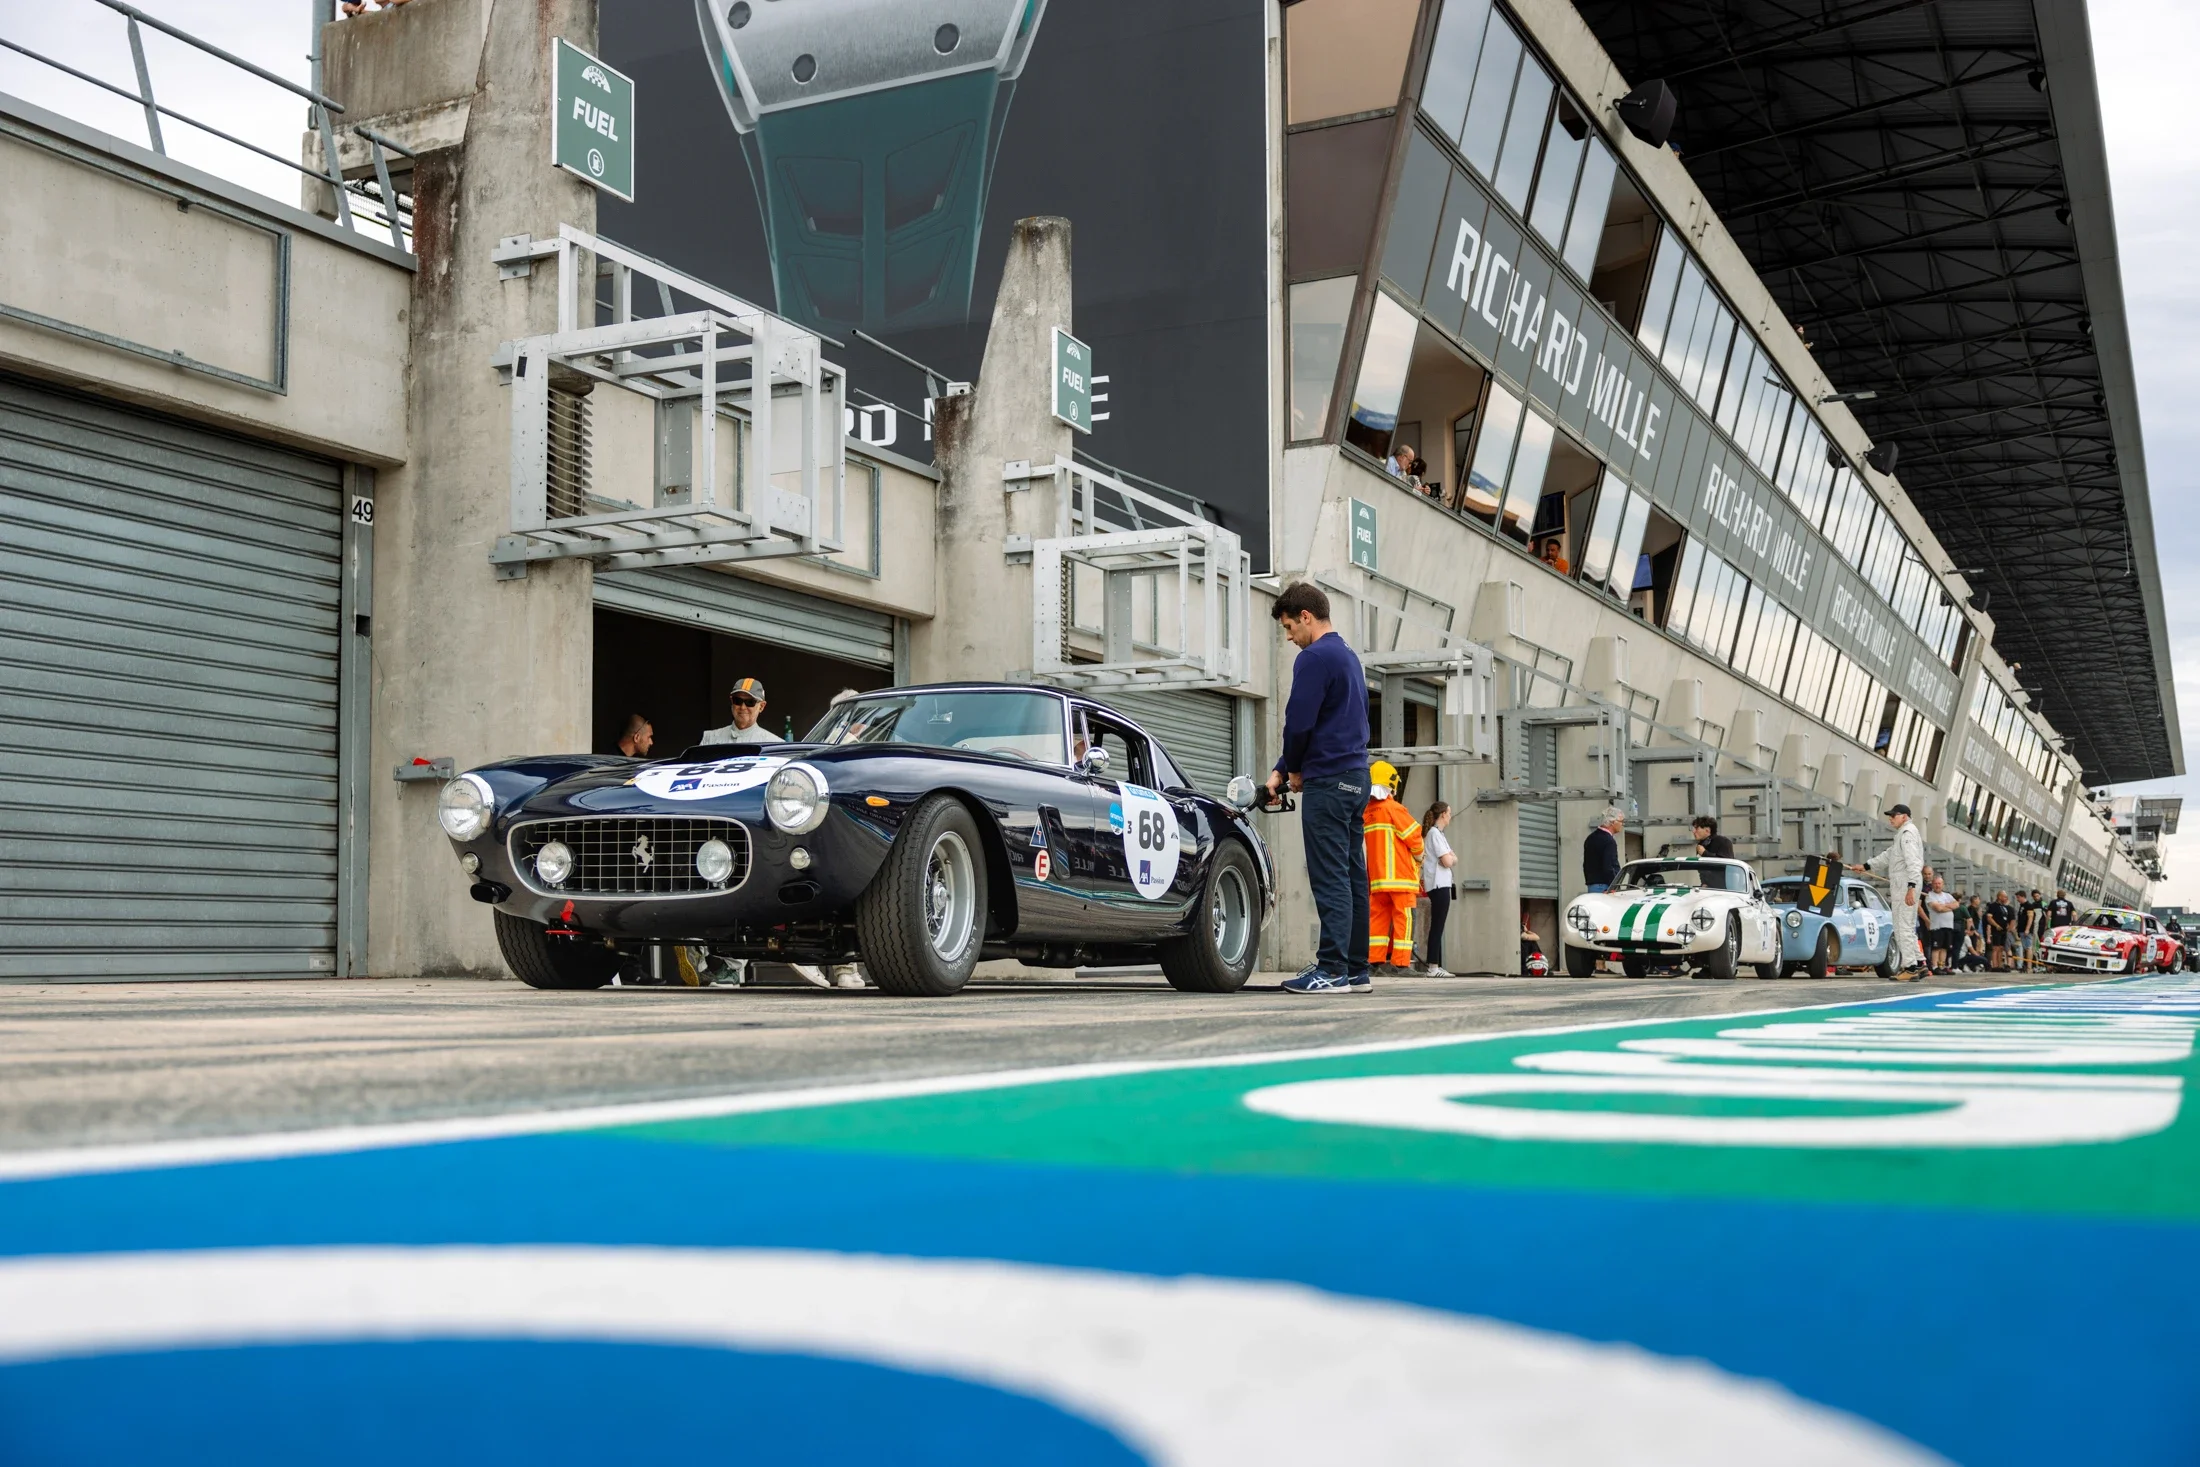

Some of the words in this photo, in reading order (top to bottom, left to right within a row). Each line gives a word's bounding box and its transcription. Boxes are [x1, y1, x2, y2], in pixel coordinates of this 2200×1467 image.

[572, 96, 619, 143] FUEL
[1446, 217, 1588, 396] RICHARD
[1586, 352, 1661, 461] MILLE
[1062, 366, 1085, 394] FUEL
[352, 499, 374, 523] 49
[1356, 526, 1372, 544] FUEL
[1702, 463, 1774, 559] RICHARD
[1769, 525, 1811, 592] MILLE
[1831, 584, 1874, 647] RICHARD
[1870, 620, 1896, 668] MILLE
[676, 762, 756, 776] 68
[1127, 820, 1133, 835] 3
[1138, 809, 1166, 852] 68
[1038, 854, 1048, 878] E
[1150, 876, 1165, 885] Passion
